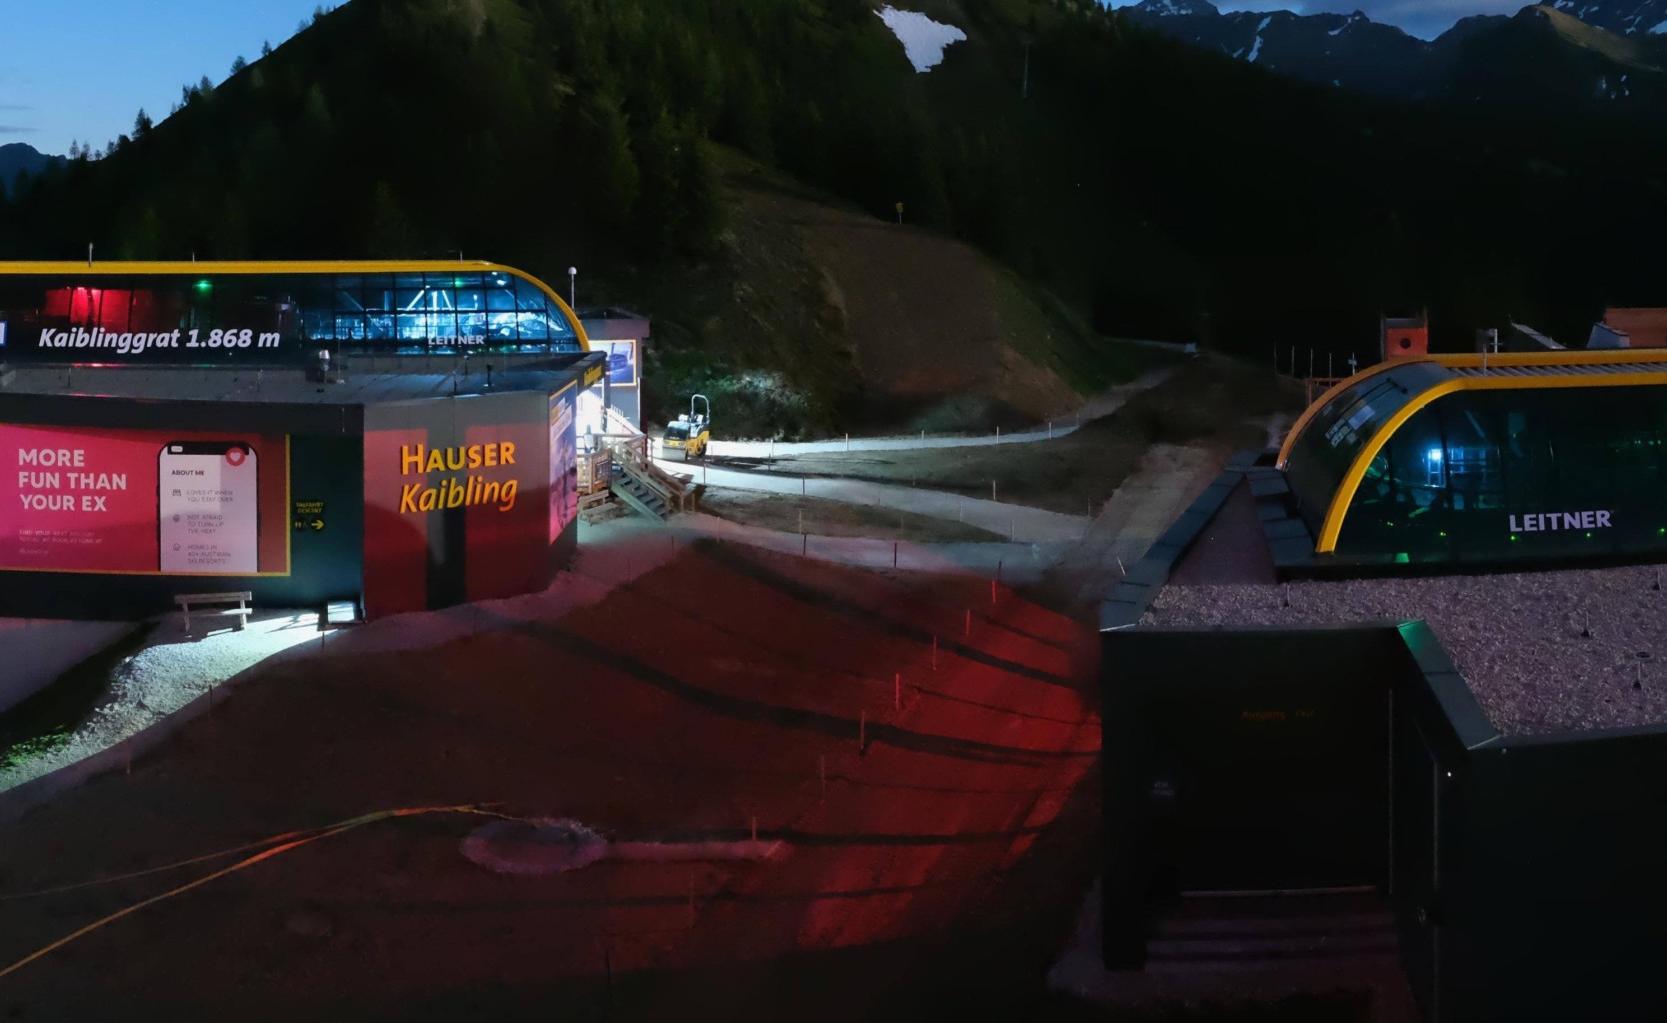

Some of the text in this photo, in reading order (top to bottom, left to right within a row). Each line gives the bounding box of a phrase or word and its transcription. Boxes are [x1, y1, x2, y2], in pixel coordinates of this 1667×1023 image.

[38, 327, 281, 354] Kaiblinggrat 1.868 m
[428, 335, 485, 345] LEITNER
[18, 448, 85, 467] MORE
[402, 441, 516, 475] HAUSER
[18, 471, 127, 490] FUN THAN
[20, 494, 107, 512] YOUR EX
[400, 475, 518, 514] Kaibling
[1509, 510, 1612, 532] LEITNER
